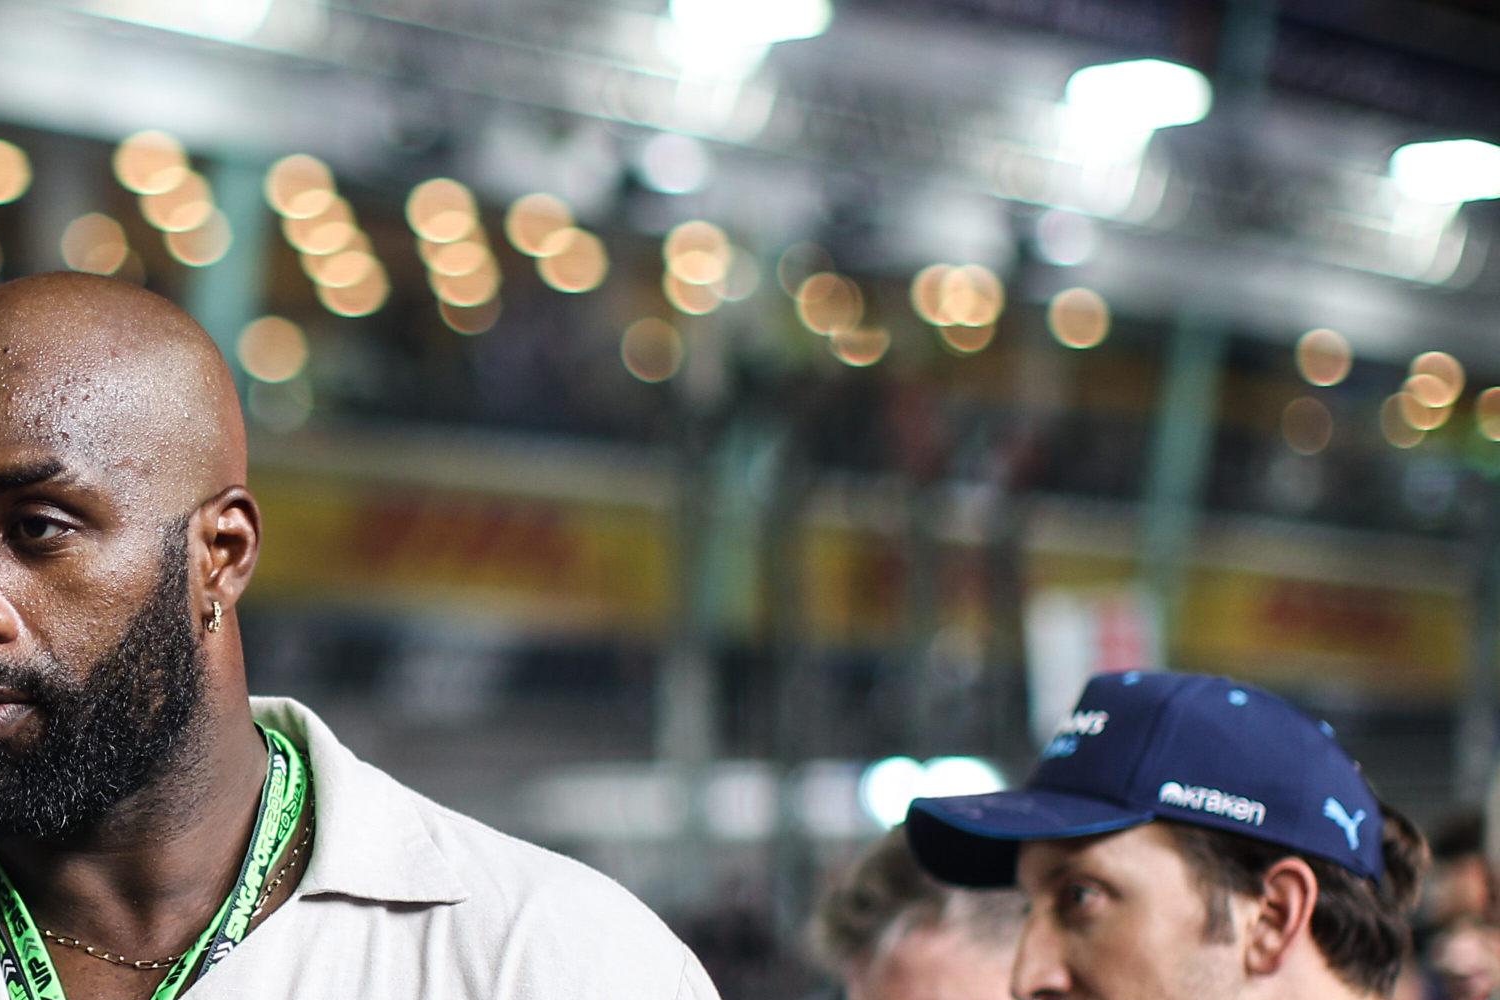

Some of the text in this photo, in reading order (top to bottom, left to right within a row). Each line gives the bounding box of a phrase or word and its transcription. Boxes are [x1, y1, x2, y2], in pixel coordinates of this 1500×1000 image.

[1183, 784, 1267, 827] kraken
[223, 826, 281, 944] SINGAPORE
[27, 957, 53, 993] VIP
